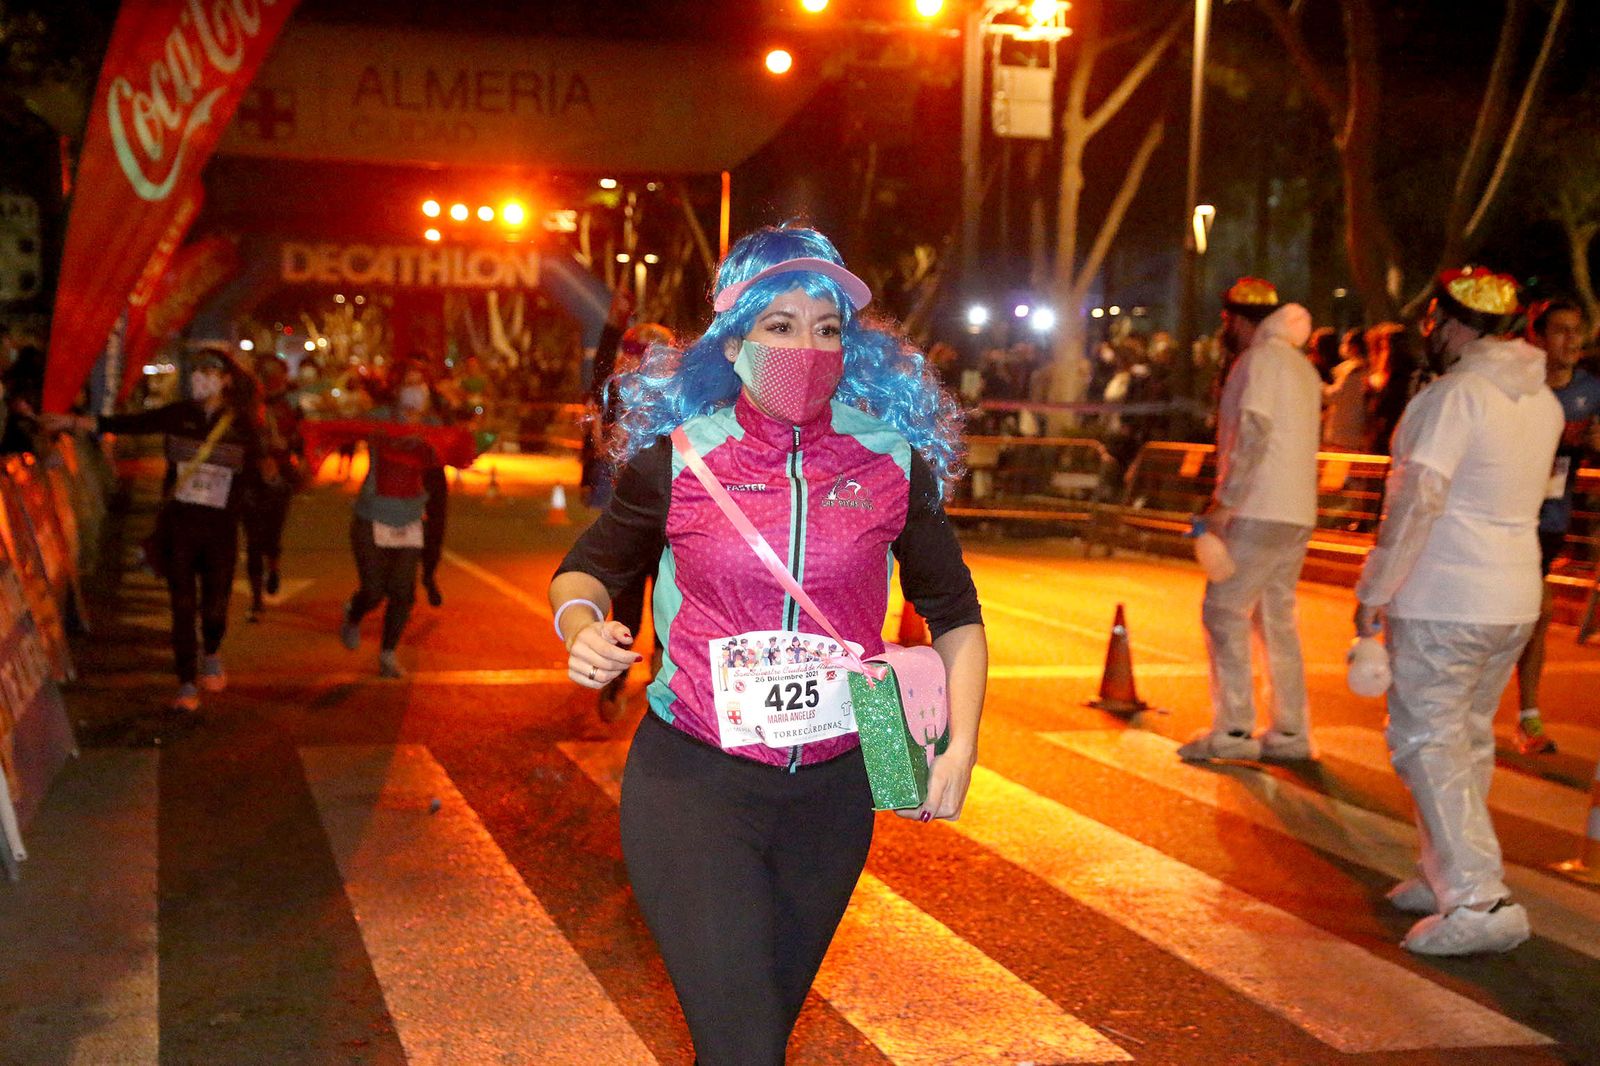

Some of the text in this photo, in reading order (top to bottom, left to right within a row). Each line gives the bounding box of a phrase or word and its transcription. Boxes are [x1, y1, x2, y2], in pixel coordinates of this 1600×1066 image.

[281, 243, 540, 288] DECATHLON
[726, 483, 766, 492] FASTER
[767, 673, 803, 682] Diciembre
[764, 680, 819, 711] 425
[768, 709, 816, 724] MARIA ANGELES
